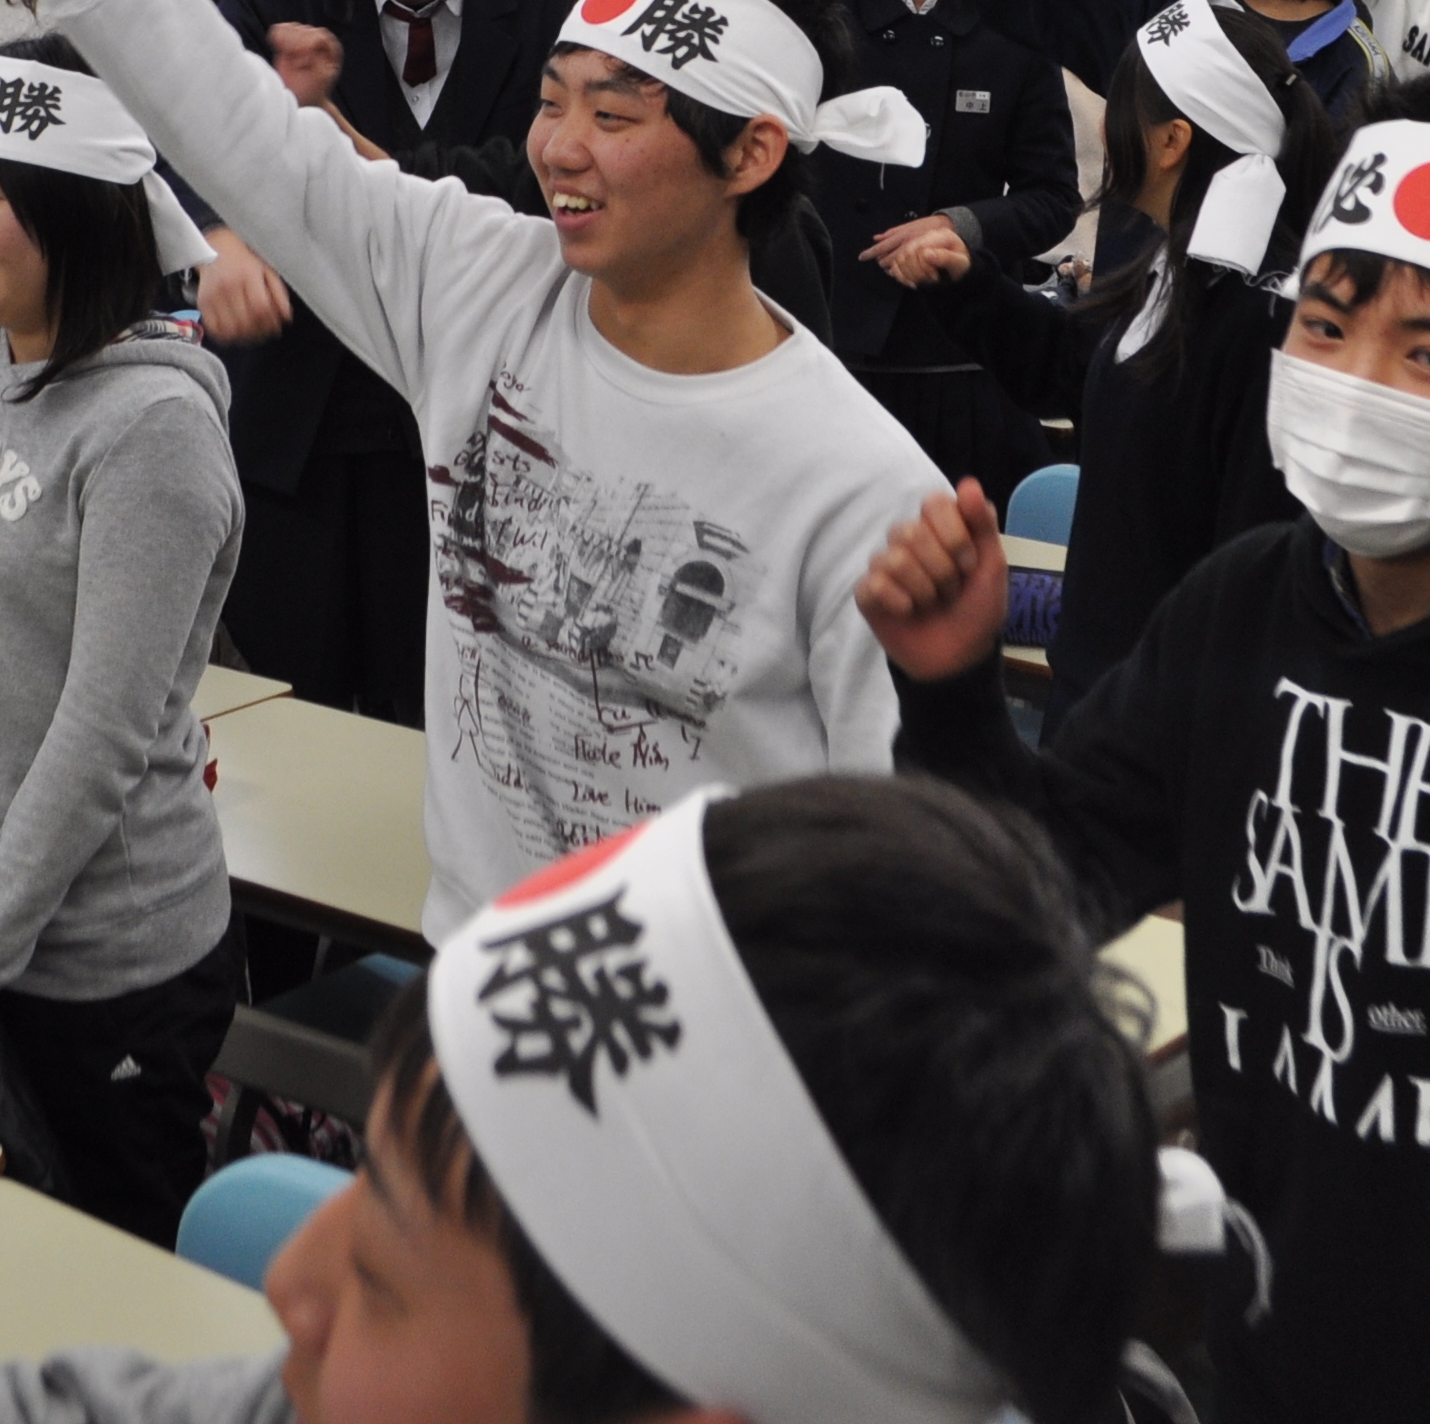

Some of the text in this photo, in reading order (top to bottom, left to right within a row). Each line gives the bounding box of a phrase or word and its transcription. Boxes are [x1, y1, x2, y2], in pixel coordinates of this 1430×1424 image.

[1146, 3, 1191, 48] 勝
[1311, 152, 1388, 235] 必
[475, 882, 682, 1123] 勝
